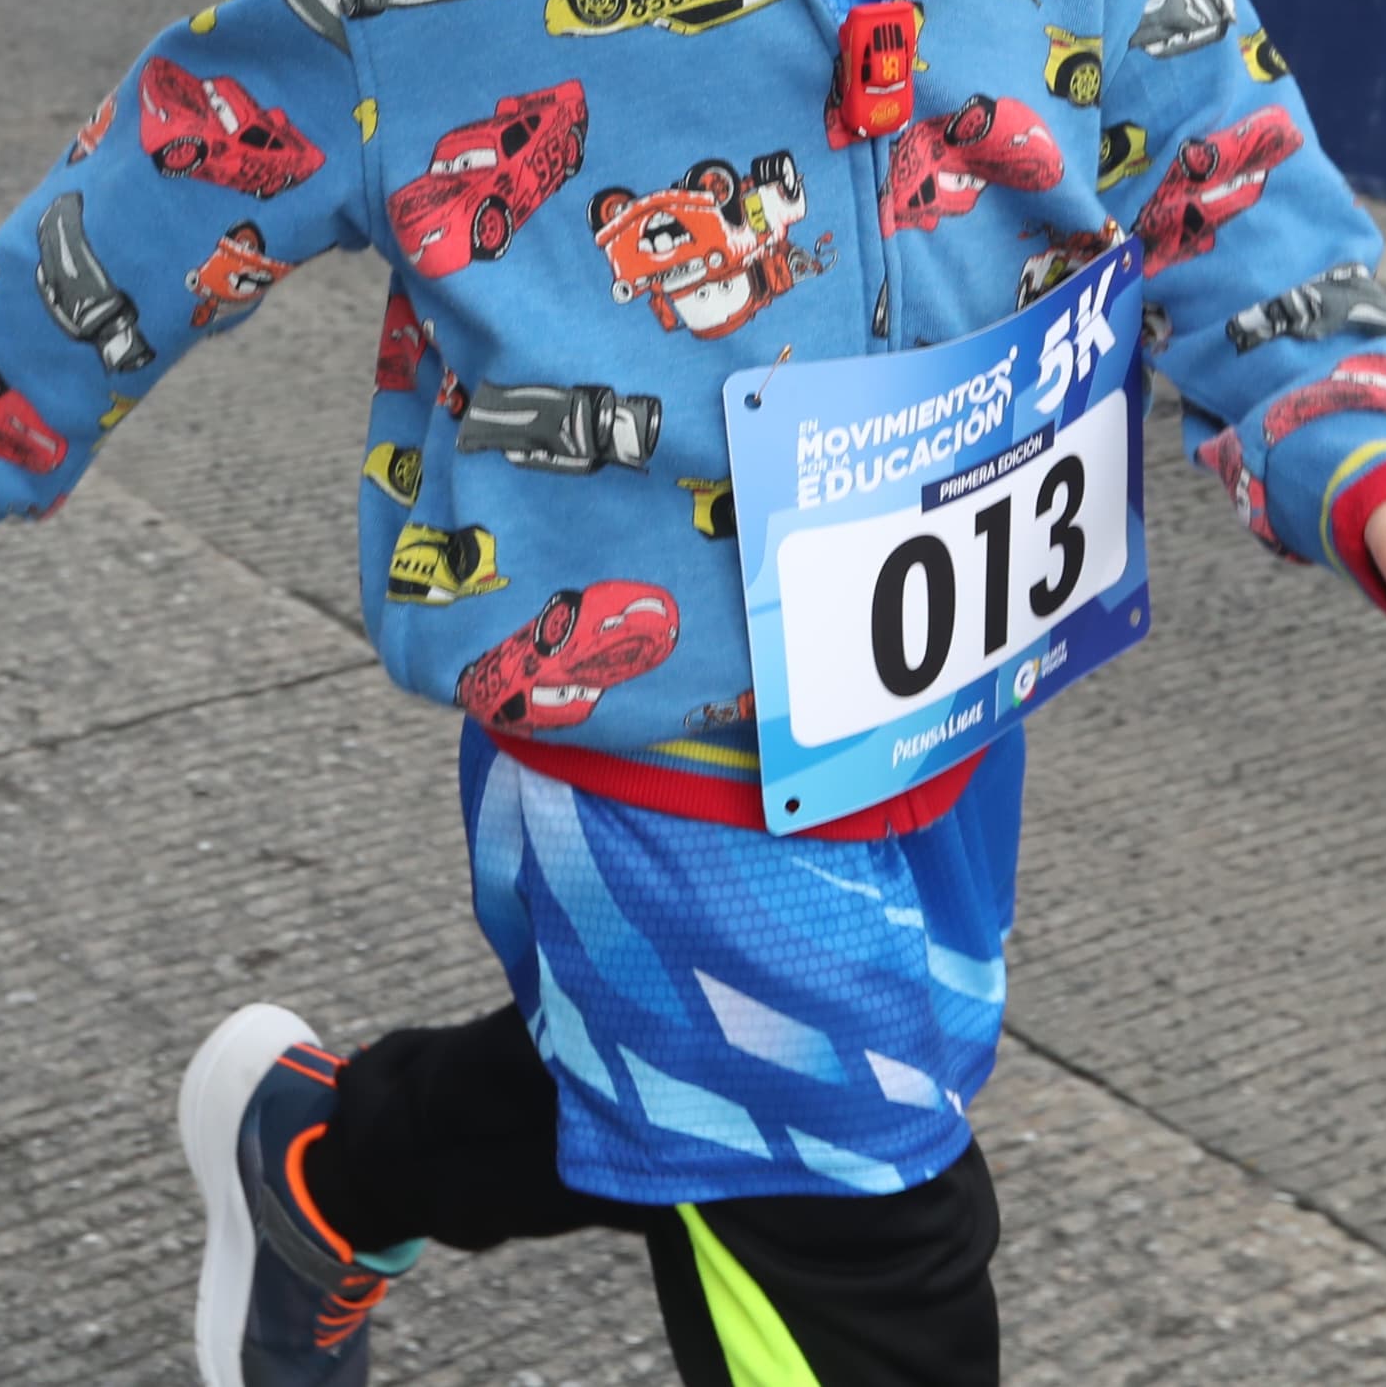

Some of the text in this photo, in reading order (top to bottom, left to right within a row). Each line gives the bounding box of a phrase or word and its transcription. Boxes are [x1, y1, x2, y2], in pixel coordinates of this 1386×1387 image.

[1033, 259, 1117, 415] 5K
[797, 373, 988, 464] MOVIMIENTO
[797, 392, 1005, 510] EDUCACIÓN
[939, 432, 1044, 503] PRIMERA EDICIÓN
[870, 454, 1086, 699] 013
[892, 699, 985, 770] PRENSA LIBRE
